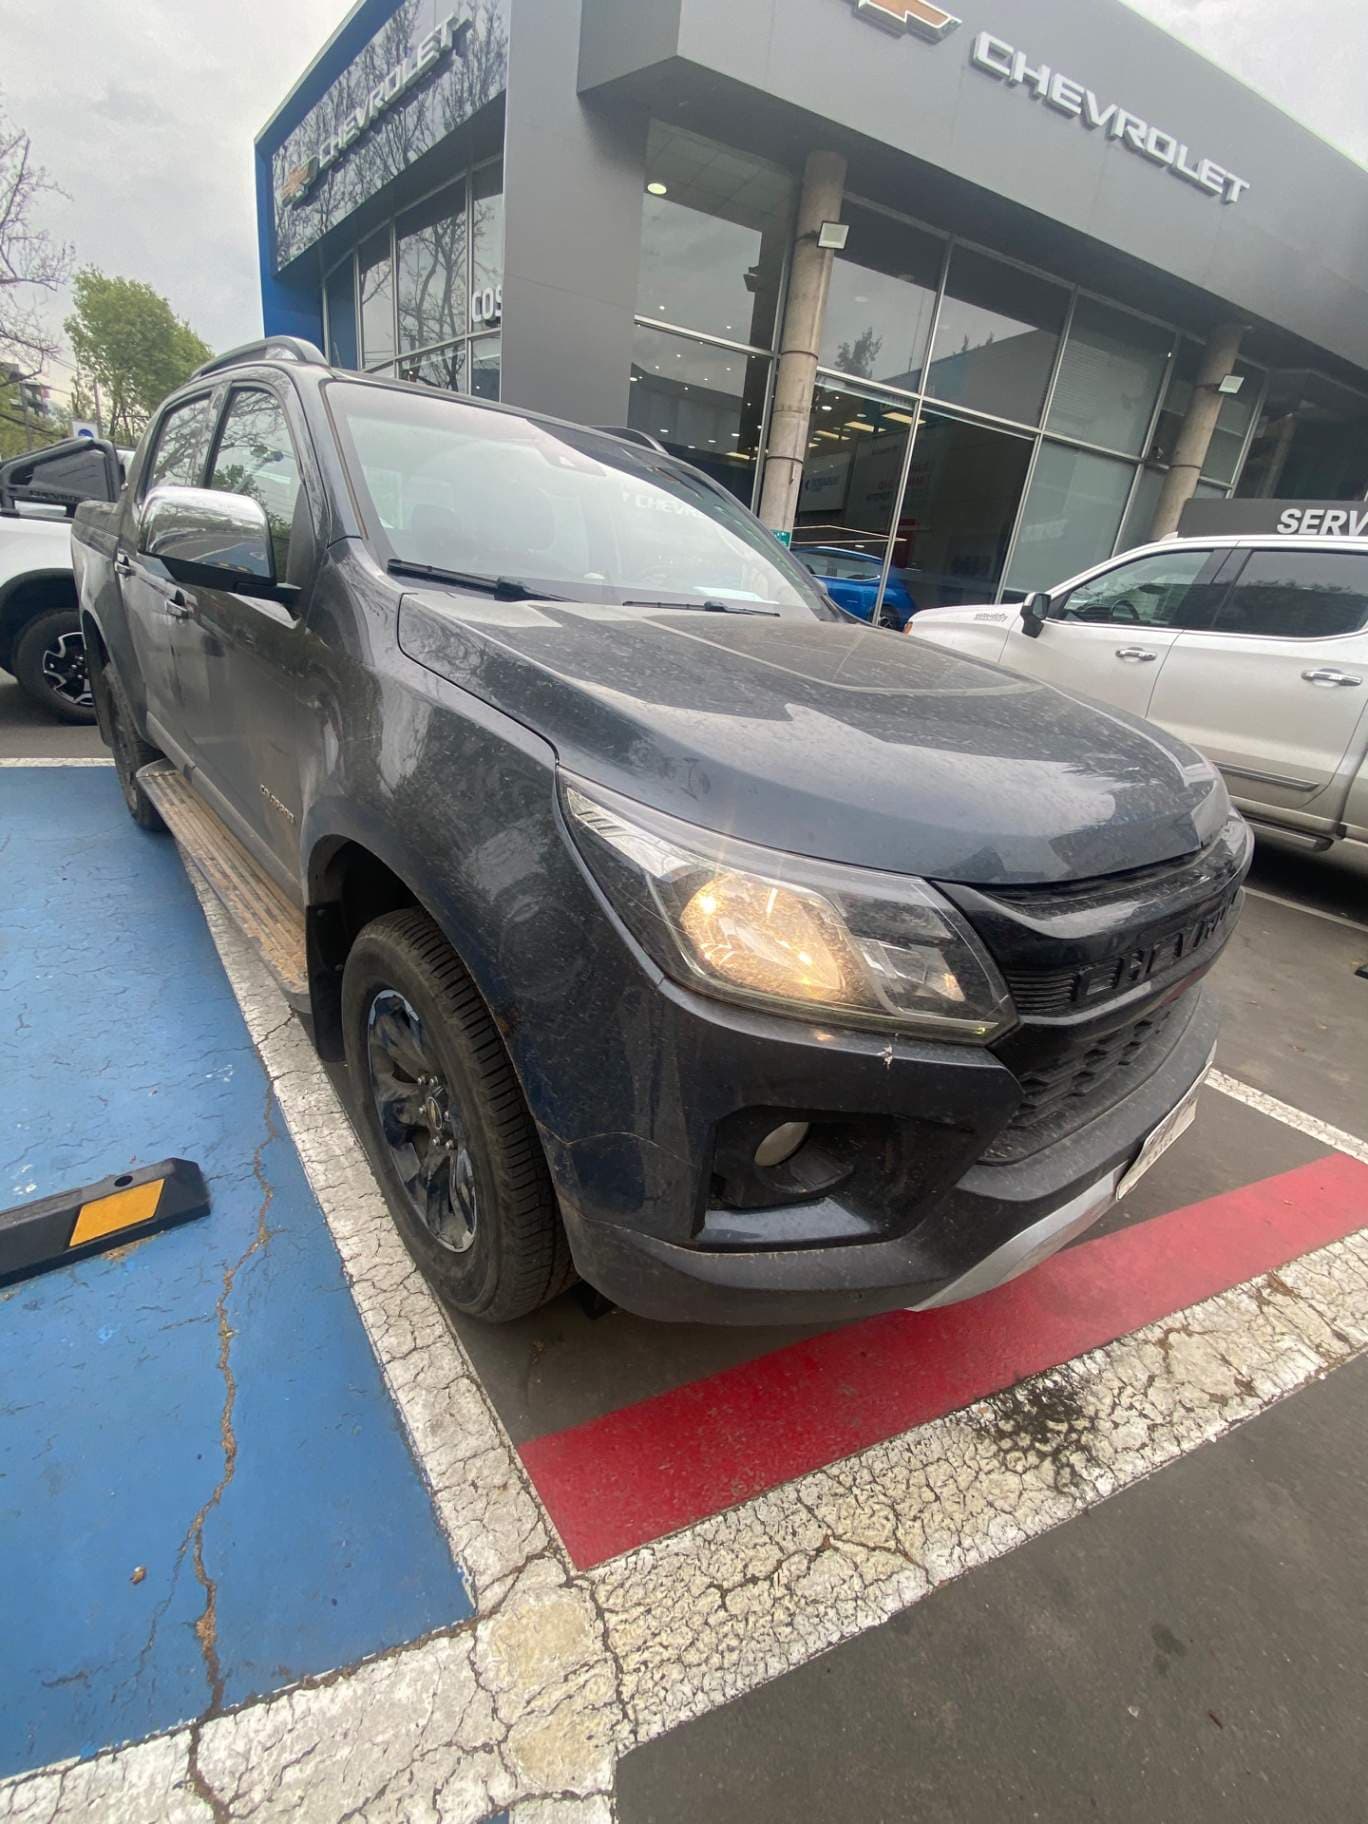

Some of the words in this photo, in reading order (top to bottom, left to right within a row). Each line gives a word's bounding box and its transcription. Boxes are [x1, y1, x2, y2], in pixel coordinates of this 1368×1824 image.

[318, 15, 472, 169] CHEVROLET
[972, 31, 1250, 203] CHEVROLET
[1277, 508, 1368, 536] SERV
